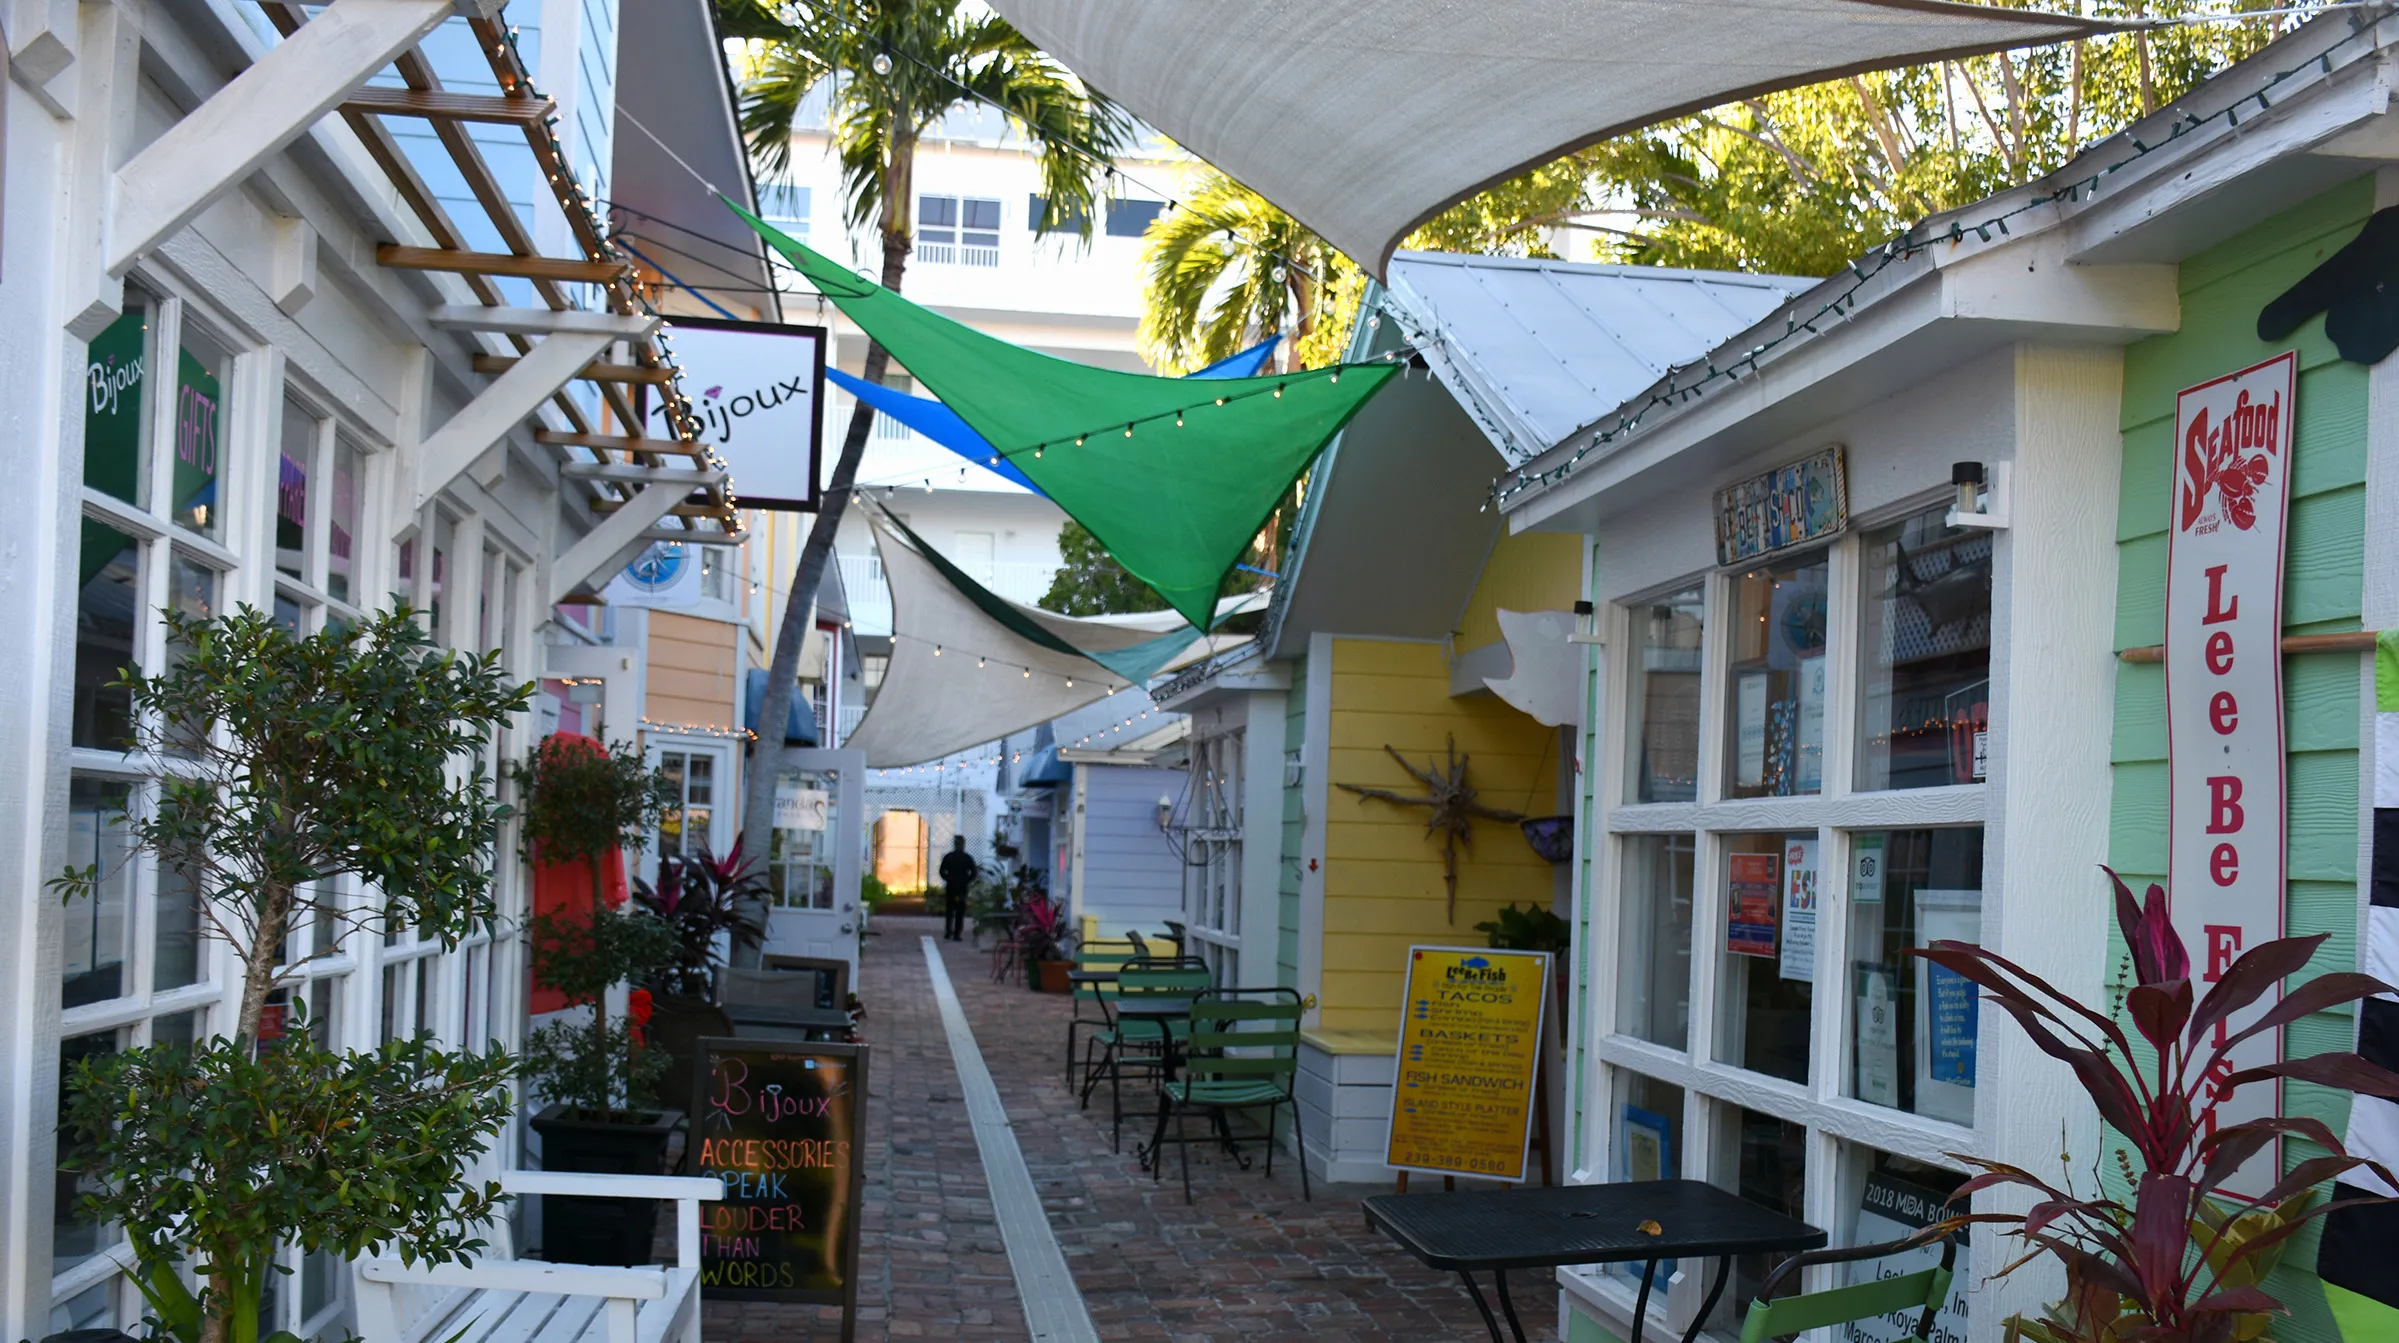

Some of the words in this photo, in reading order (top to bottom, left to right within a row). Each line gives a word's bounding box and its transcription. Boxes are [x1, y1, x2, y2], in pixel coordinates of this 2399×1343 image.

[88, 355, 144, 416] Bijoux
[651, 376, 808, 444] Bijoux
[178, 383, 217, 476] GIFTS
[2202, 564, 2239, 736] Lee
[2205, 776, 2245, 887] Be
[1437, 989, 1513, 1004] TACOS
[1419, 1028, 1519, 1044] BASKETS
[711, 1057, 832, 1122] Bijoux
[1406, 1070, 1437, 1084] FISH
[1441, 1072, 1524, 1091] SANDWICH
[1404, 1098, 1438, 1108] ISLAND
[1441, 1100, 1472, 1111] STYLE
[1475, 1103, 1519, 1116] PLATTER
[700, 1138, 850, 1170] ACCESSORIES
[1866, 1183, 1894, 1209] 2018
[700, 1204, 805, 1232] LOUDER
[701, 1233, 760, 1258] THAN
[700, 1260, 795, 1288] WORDS
